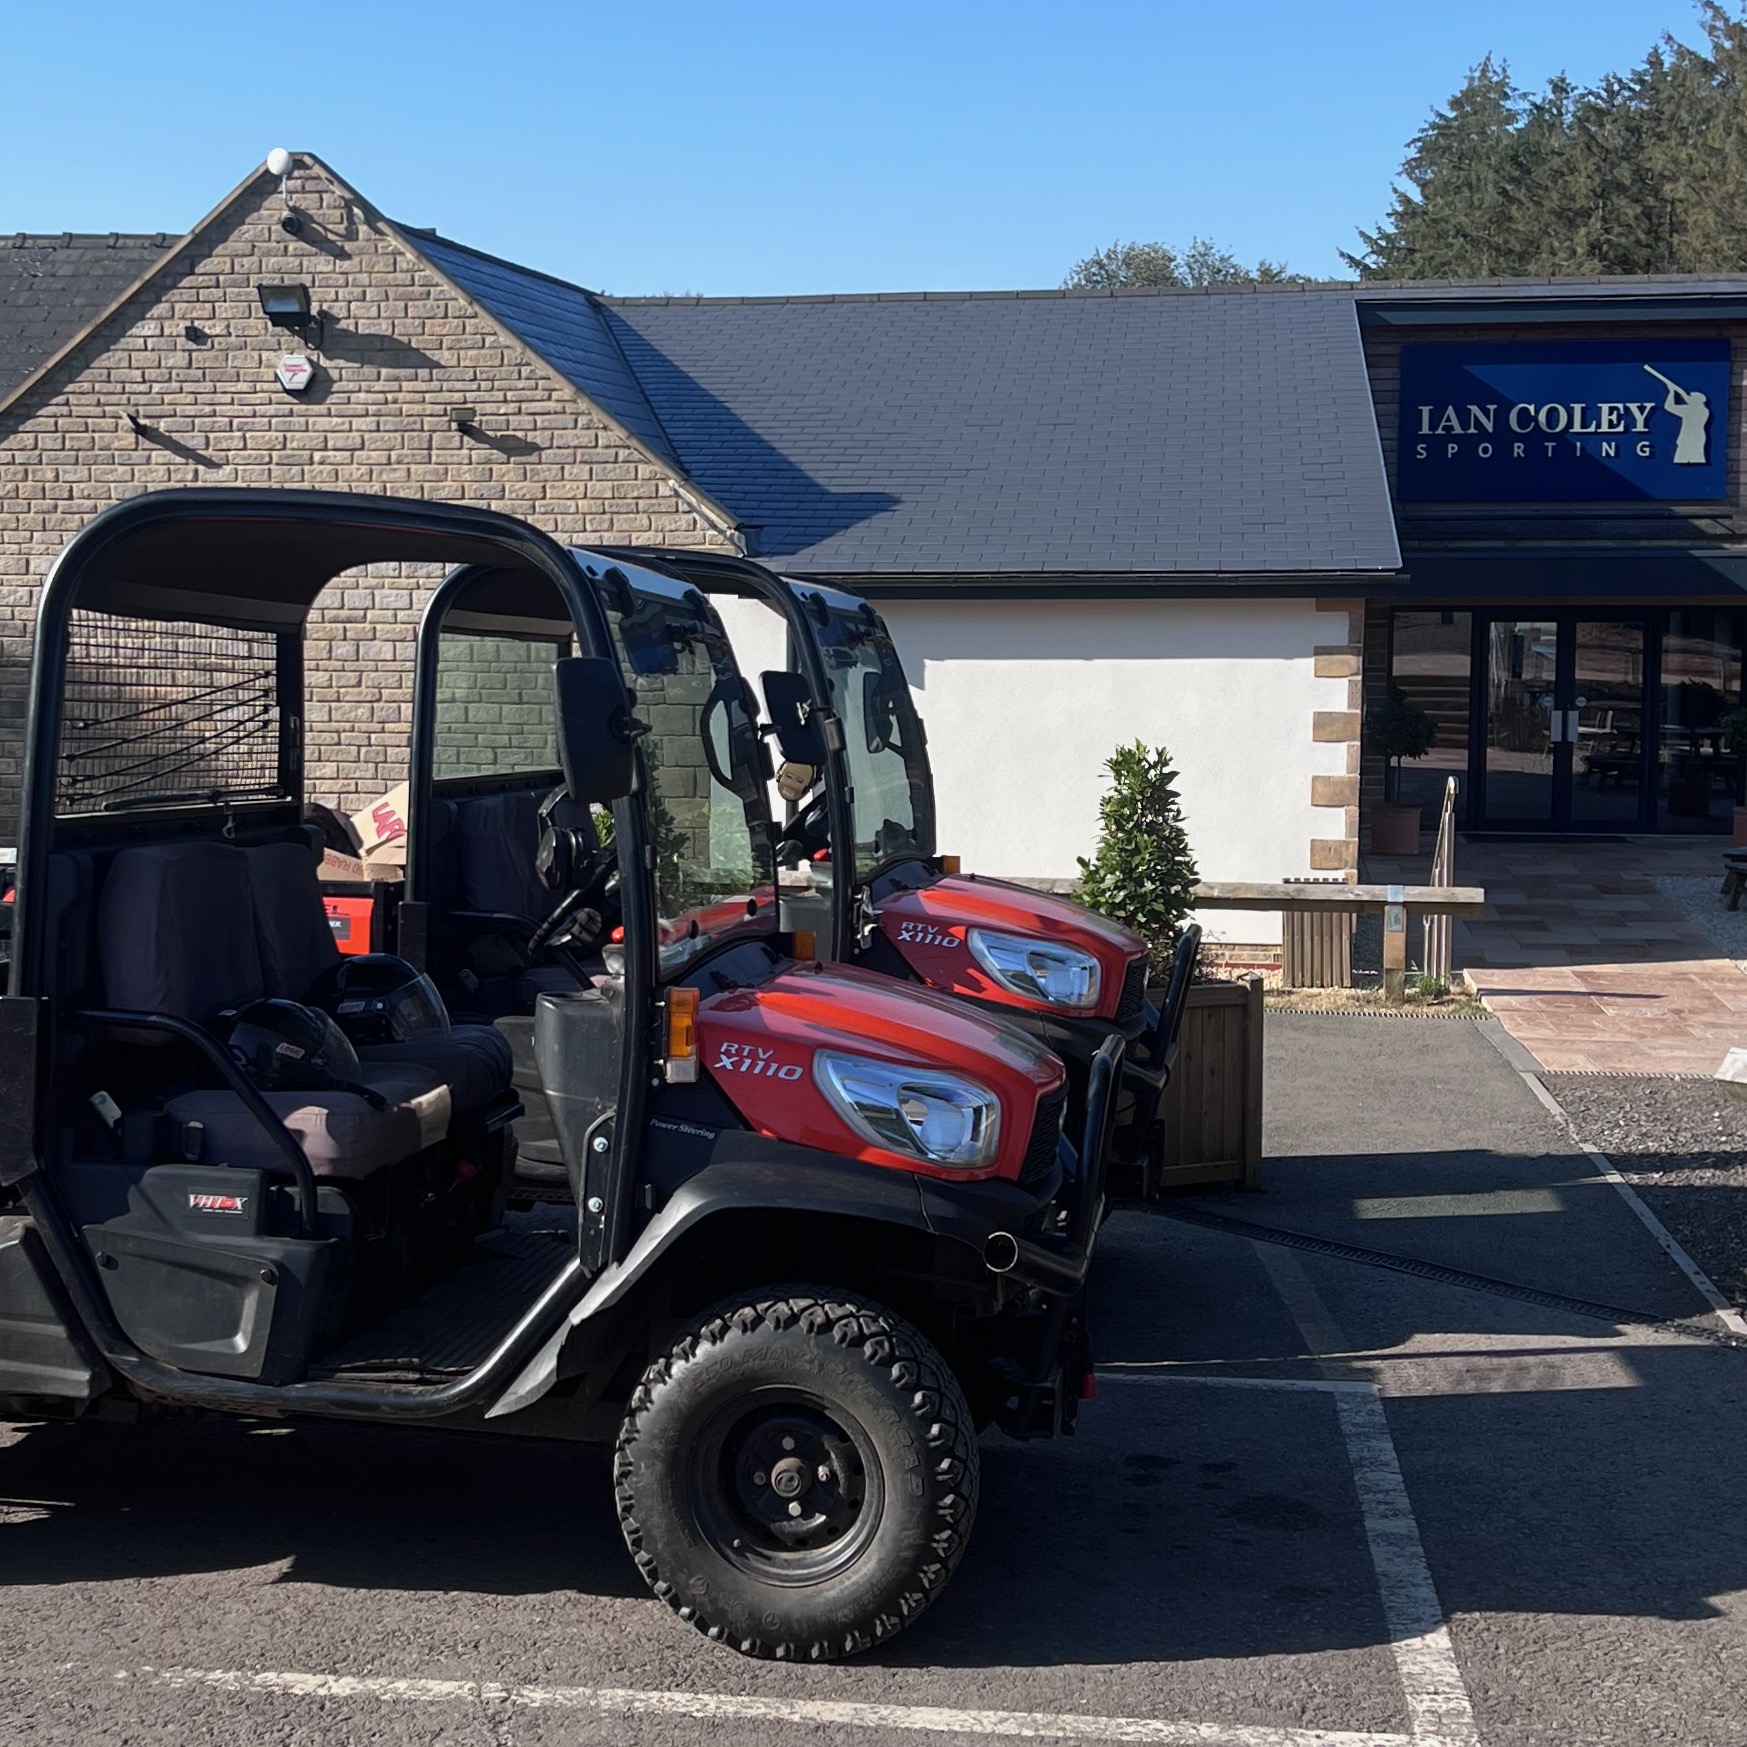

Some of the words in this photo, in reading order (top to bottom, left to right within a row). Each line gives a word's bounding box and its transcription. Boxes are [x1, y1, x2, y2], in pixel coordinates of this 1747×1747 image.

[1417, 404, 1498, 435] IAN
[1508, 402, 1656, 434] COLEY
[1415, 440, 1652, 459] SPORTING
[901, 921, 940, 934] RTV
[897, 930, 961, 948] X1110
[720, 1042, 775, 1060] RTV
[713, 1054, 804, 1080] X1110
[678, 1124, 716, 1140] Steering
